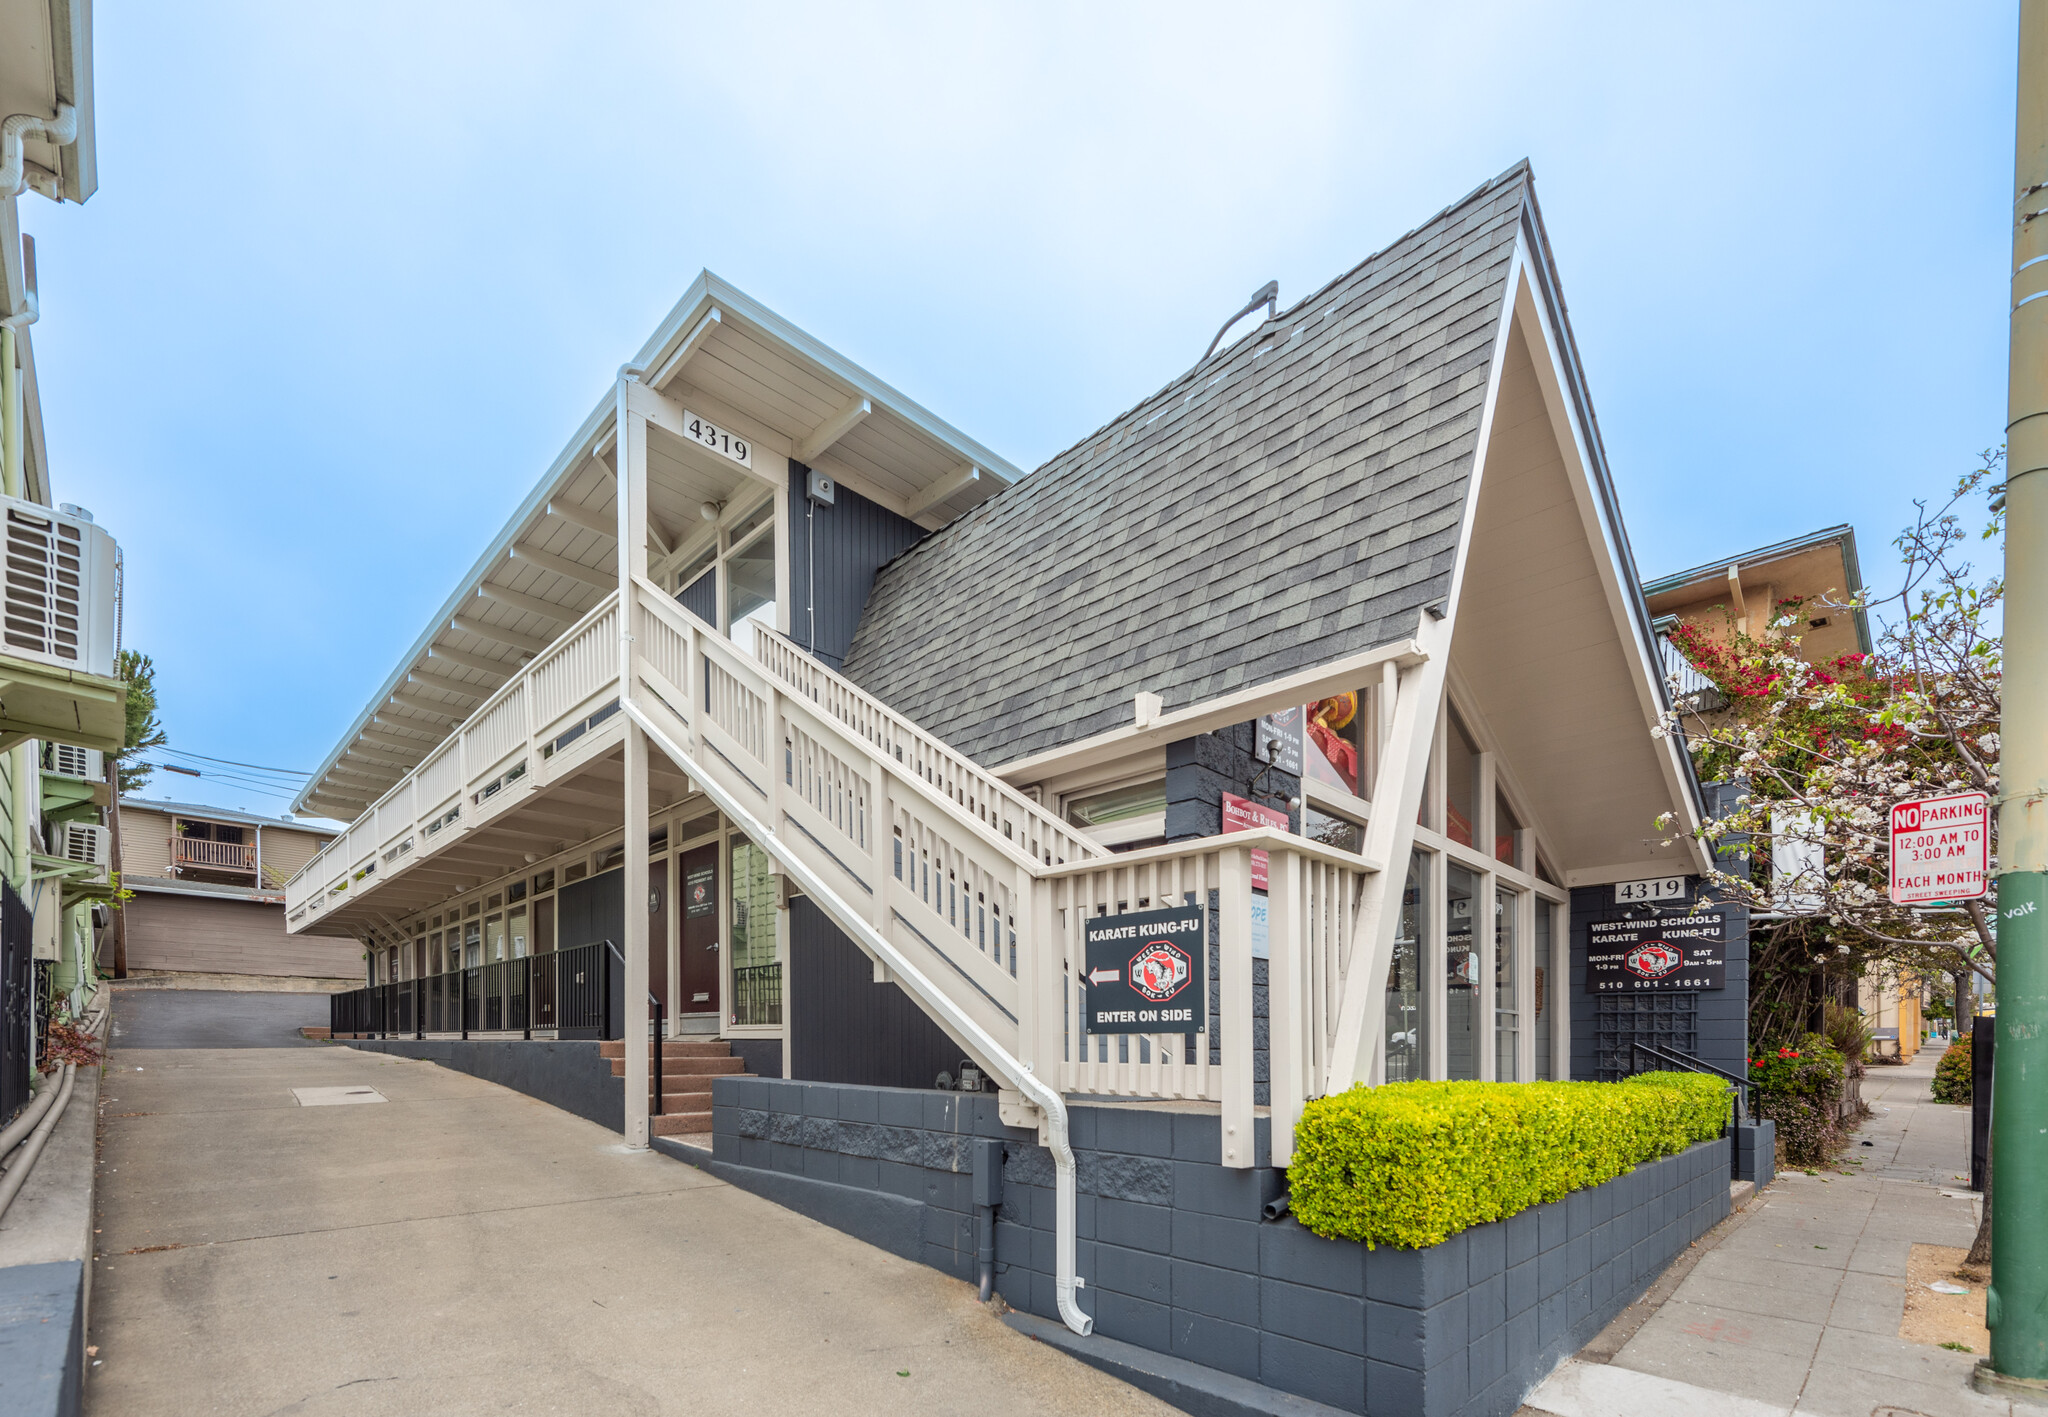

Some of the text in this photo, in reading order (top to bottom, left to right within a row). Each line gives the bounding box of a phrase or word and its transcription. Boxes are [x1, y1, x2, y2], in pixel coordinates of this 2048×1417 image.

[689, 419, 747, 460] 4319
[1261, 720, 1283, 738] MON-FRI
[1252, 811, 1258, 822] &
[1894, 802, 1982, 829] NO PARKING
[1900, 830, 1979, 849] 12:00 AM TO
[1912, 845, 1965, 861] 3:00 AM
[1898, 870, 1981, 889] EACH MONTH
[1621, 880, 1679, 899] 4319
[1935, 888, 1970, 896] SWEEPING
[1089, 919, 1199, 942] KARATE KUNG-FU
[1591, 915, 1721, 932] WEST-WIND SCHOOLS
[1592, 928, 1720, 944] KARATE KUNG-FU
[1589, 954, 1624, 962] MON-FRI
[1097, 1009, 1192, 1023] ENTER ON SIDE
